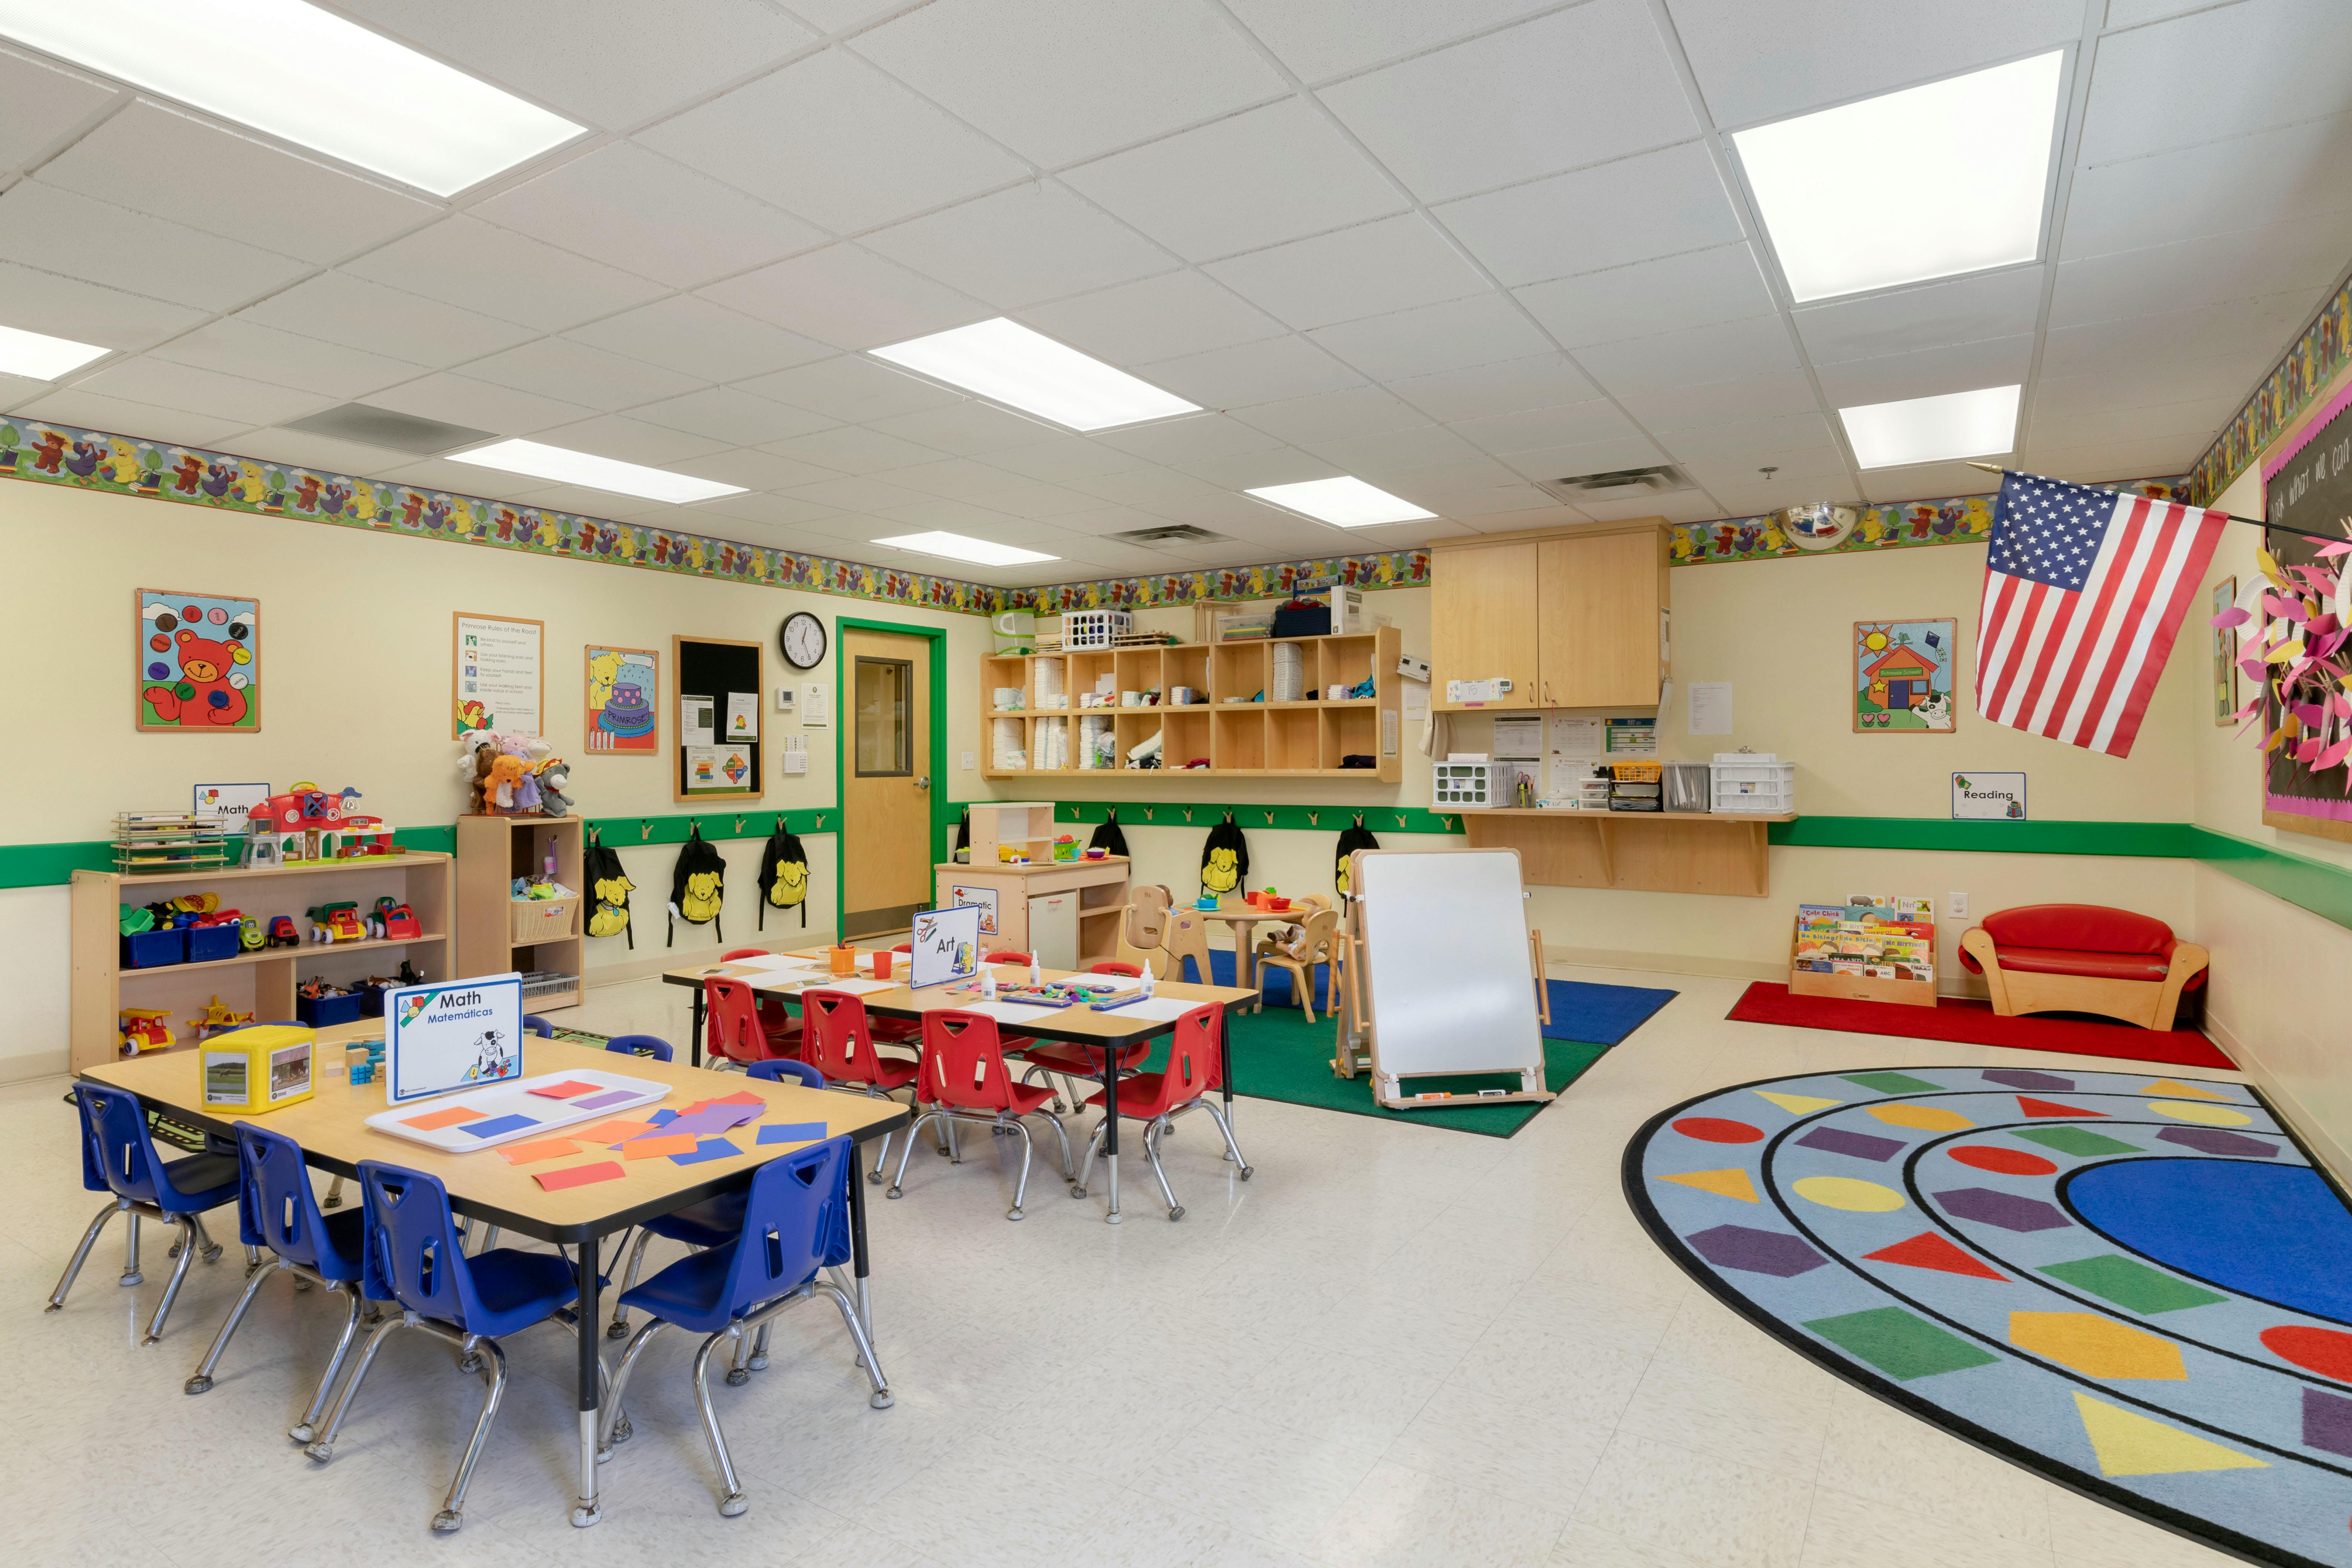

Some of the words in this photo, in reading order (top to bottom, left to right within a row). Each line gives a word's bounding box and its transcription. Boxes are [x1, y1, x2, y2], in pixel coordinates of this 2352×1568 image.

[2289, 465, 2309, 506] what
[2316, 452, 2326, 482] we
[2332, 438, 2349, 476] can
[233, 626, 244, 637] black
[179, 686, 192, 697] green
[1468, 685, 1478, 695] 15
[608, 710, 646, 724] PRIMROSE
[1964, 791, 2013, 801] Reading
[218, 805, 249, 815] Math
[936, 937, 955, 954] Art
[439, 991, 481, 1009] Math
[427, 1009, 493, 1024] Matemáticas
